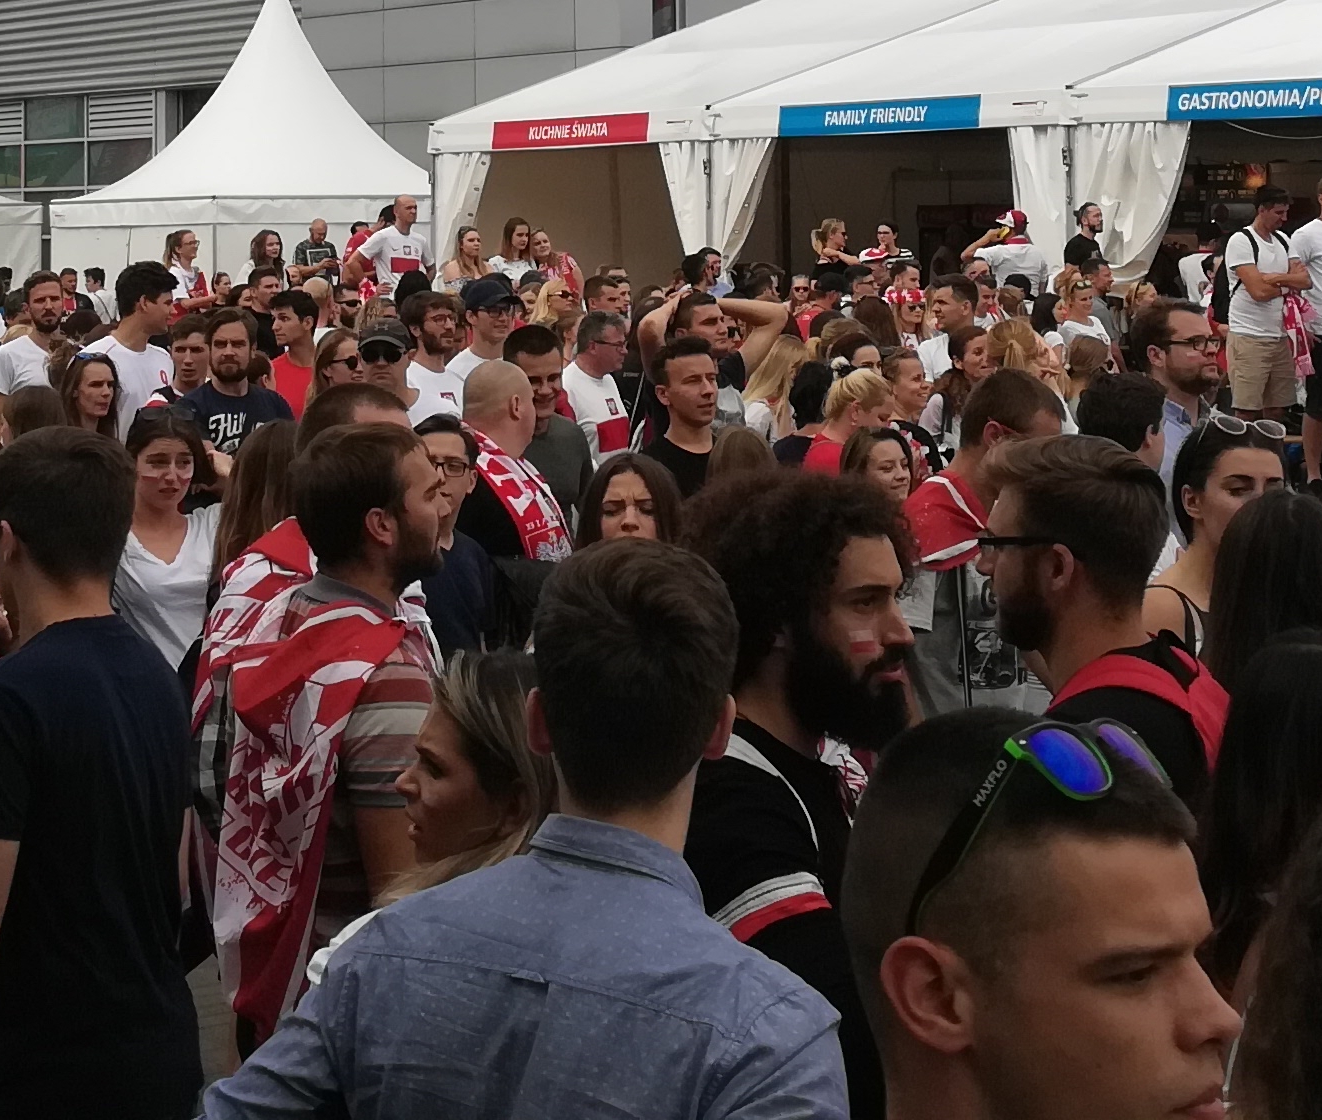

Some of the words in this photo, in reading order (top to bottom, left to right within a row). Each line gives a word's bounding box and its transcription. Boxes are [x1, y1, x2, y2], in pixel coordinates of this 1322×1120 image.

[824, 108, 866, 127] FAMILY
[869, 105, 928, 124] FRIENDLY
[528, 123, 570, 141] KUCHNIE
[571, 118, 608, 139] ŚWIATA
[972, 759, 1008, 807] MAXFLO
